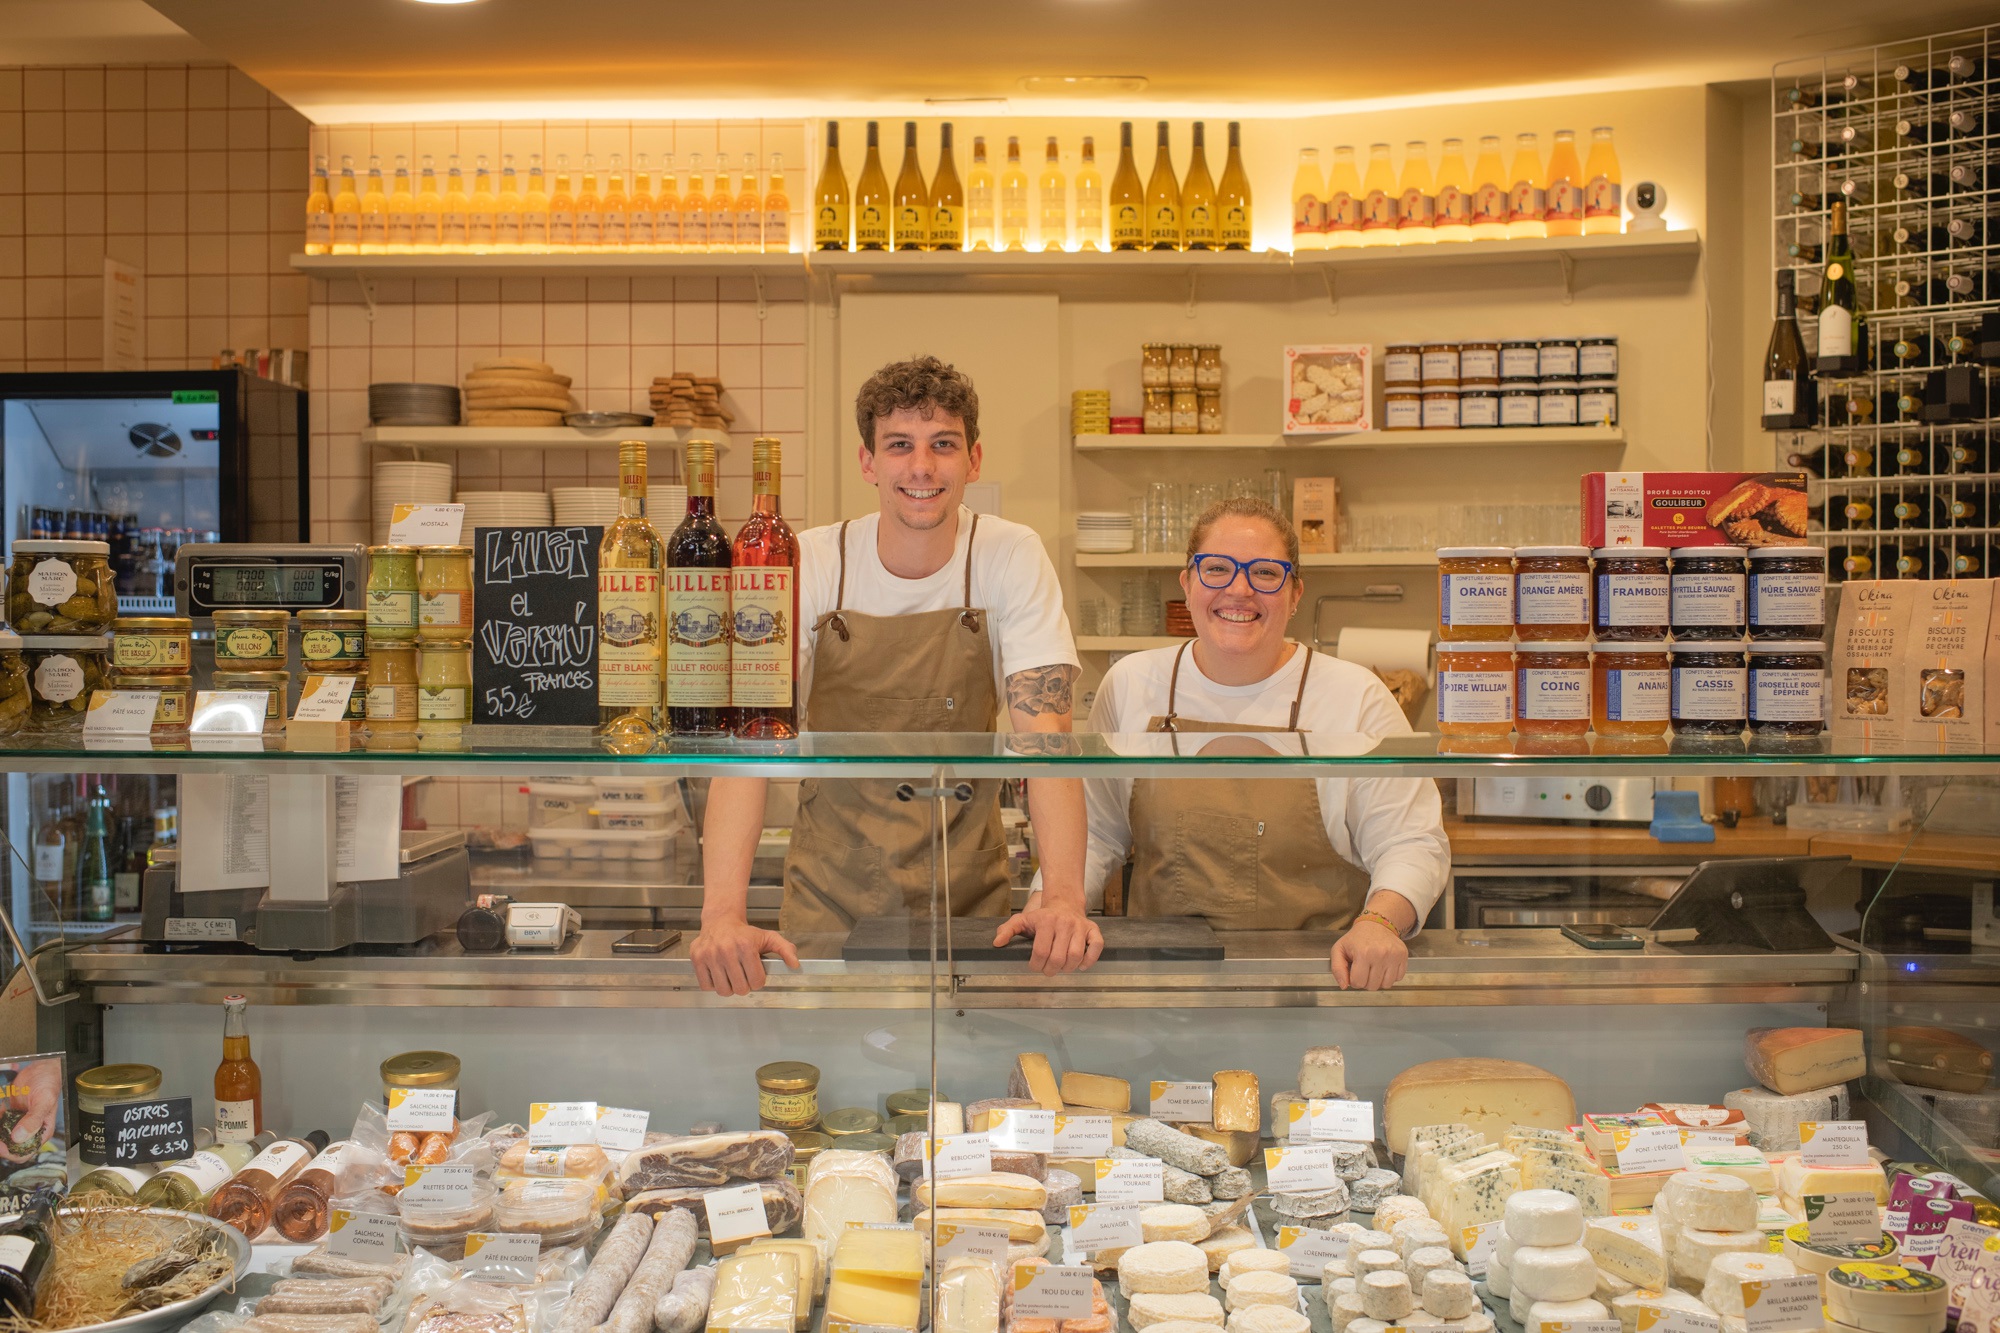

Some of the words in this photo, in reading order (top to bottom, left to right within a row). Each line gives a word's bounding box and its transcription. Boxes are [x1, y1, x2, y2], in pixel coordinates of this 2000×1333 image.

[624, 475, 643, 484] LILLET
[754, 472, 772, 481] LILLET
[668, 575, 731, 592] LILLET
[1460, 587, 1507, 596] ORANGE
[1522, 586, 1556, 595] ORANGE
[1558, 583, 1584, 594] AMÈRE
[1613, 587, 1668, 596] FRAMBOISE
[1672, 585, 1702, 594] MYRTILLE
[1703, 585, 1736, 593] SAUVAGE
[1761, 585, 1784, 594] MÛRE
[1849, 629, 1894, 637] BISCUITS
[1928, 627, 1966, 635] BISCUITS
[1937, 642, 1964, 650] CHÈVRE
[624, 664, 654, 672] BLANC
[671, 663, 695, 672] LILLET
[700, 663, 729, 672] ROUGE
[755, 661, 780, 671] ROSÉ
[1471, 683, 1507, 692] WILLIAM
[1541, 682, 1580, 691] COING
[1638, 682, 1668, 690] ANANAS
[1695, 680, 1734, 688] CASSIS
[1773, 688, 1809, 696] ÉPÉPINÉE
[224, 1120, 248, 1130] POMME
[601, 1125, 629, 1133] SALCHICHA
[1635, 1146, 1650, 1154] PONT
[1304, 1163, 1329, 1171] CENDRÉE
[1912, 1180, 1931, 1189] Cremo
[1929, 1202, 1950, 1210] Cremo
[1828, 1210, 1864, 1218] CAMEMBERT
[1100, 1220, 1130, 1229] SAUVAGET
[355, 1230, 384, 1238] SALCHICHA
[1962, 1223, 1990, 1236] cremo
[352, 1238, 384, 1246] CONFITADA
[1304, 1250, 1338, 1259] LORENTHYM
[1767, 1297, 1789, 1305] BRILLAT
[1790, 1294, 1818, 1303] SAVARIN
[1779, 1304, 1808, 1313] TRUFADO
